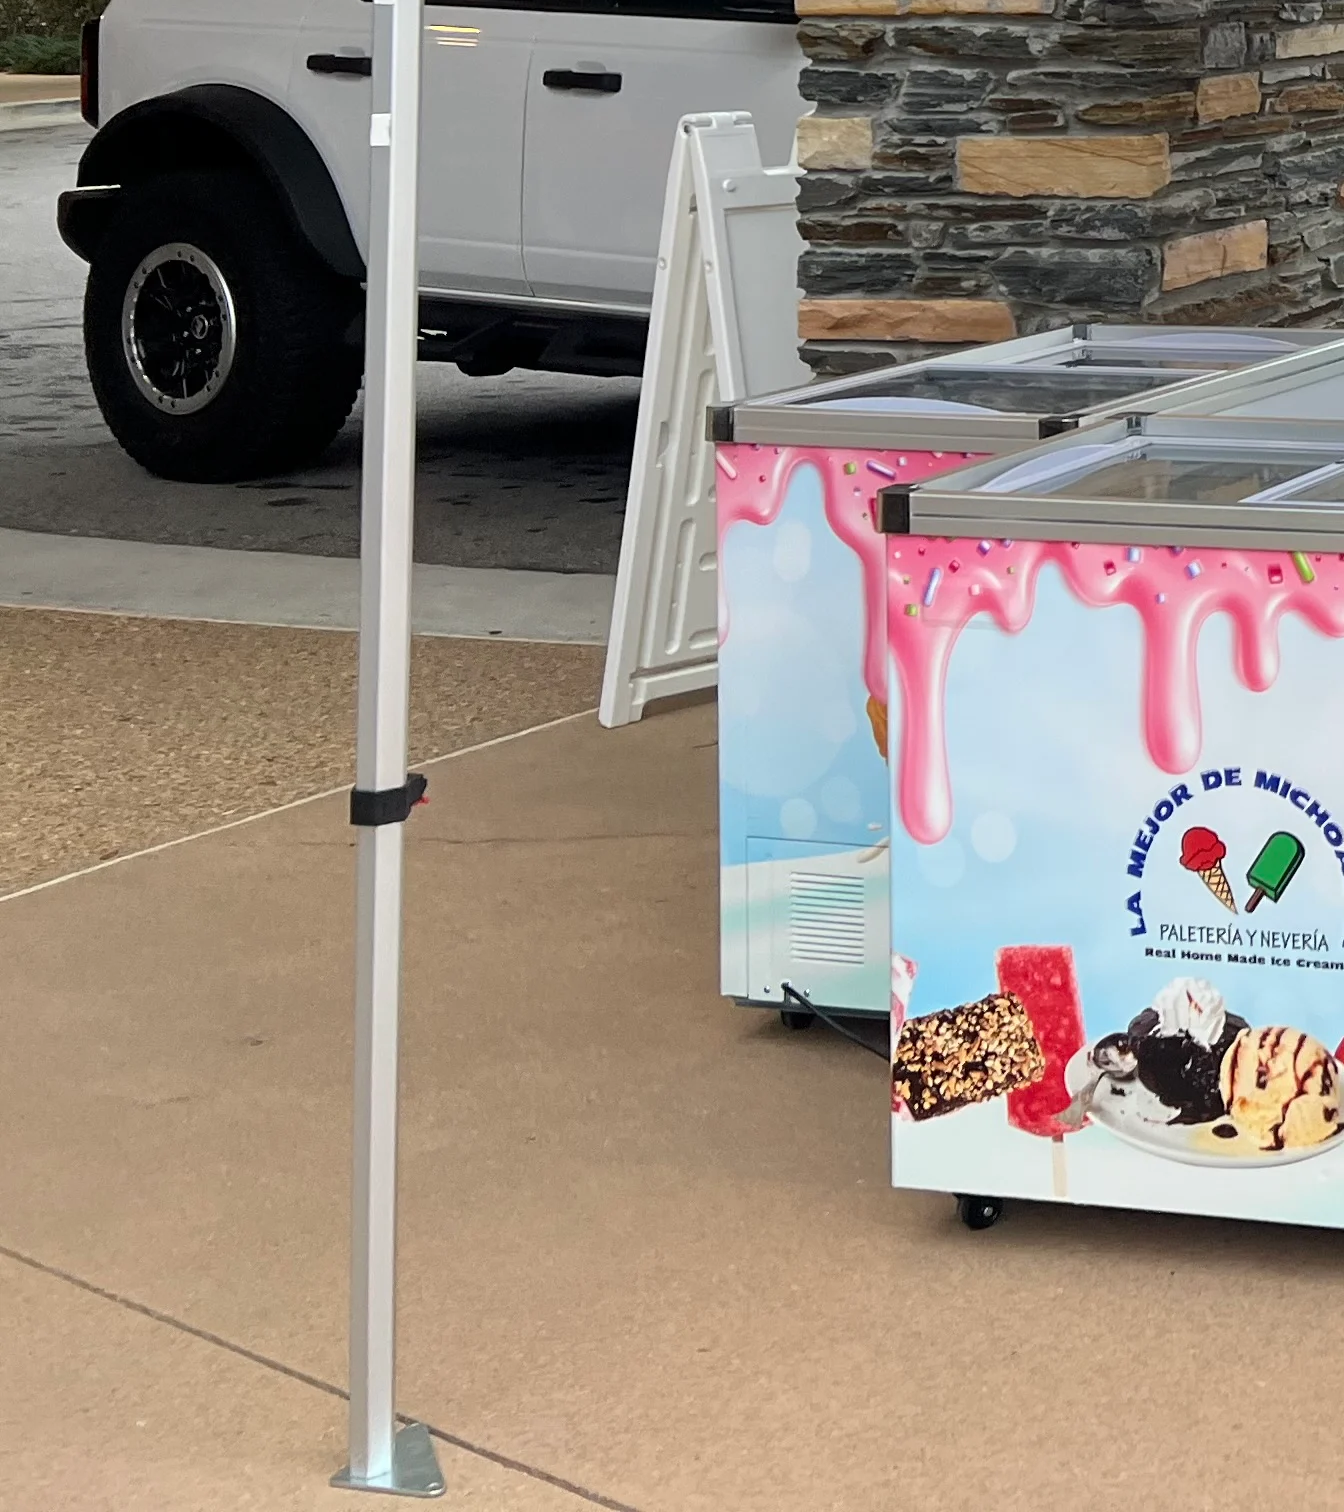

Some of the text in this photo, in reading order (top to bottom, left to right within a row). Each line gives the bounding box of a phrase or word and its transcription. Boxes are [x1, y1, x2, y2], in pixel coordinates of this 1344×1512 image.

[1199, 767, 1242, 792] DE
[1127, 782, 1195, 879] MEJOR
[1126, 890, 1147, 937] LA
[1159, 922, 1330, 952] PALETERÍA Y NEVERÍA
[1144, 947, 1344, 971] Real Home Made Ice Cream
